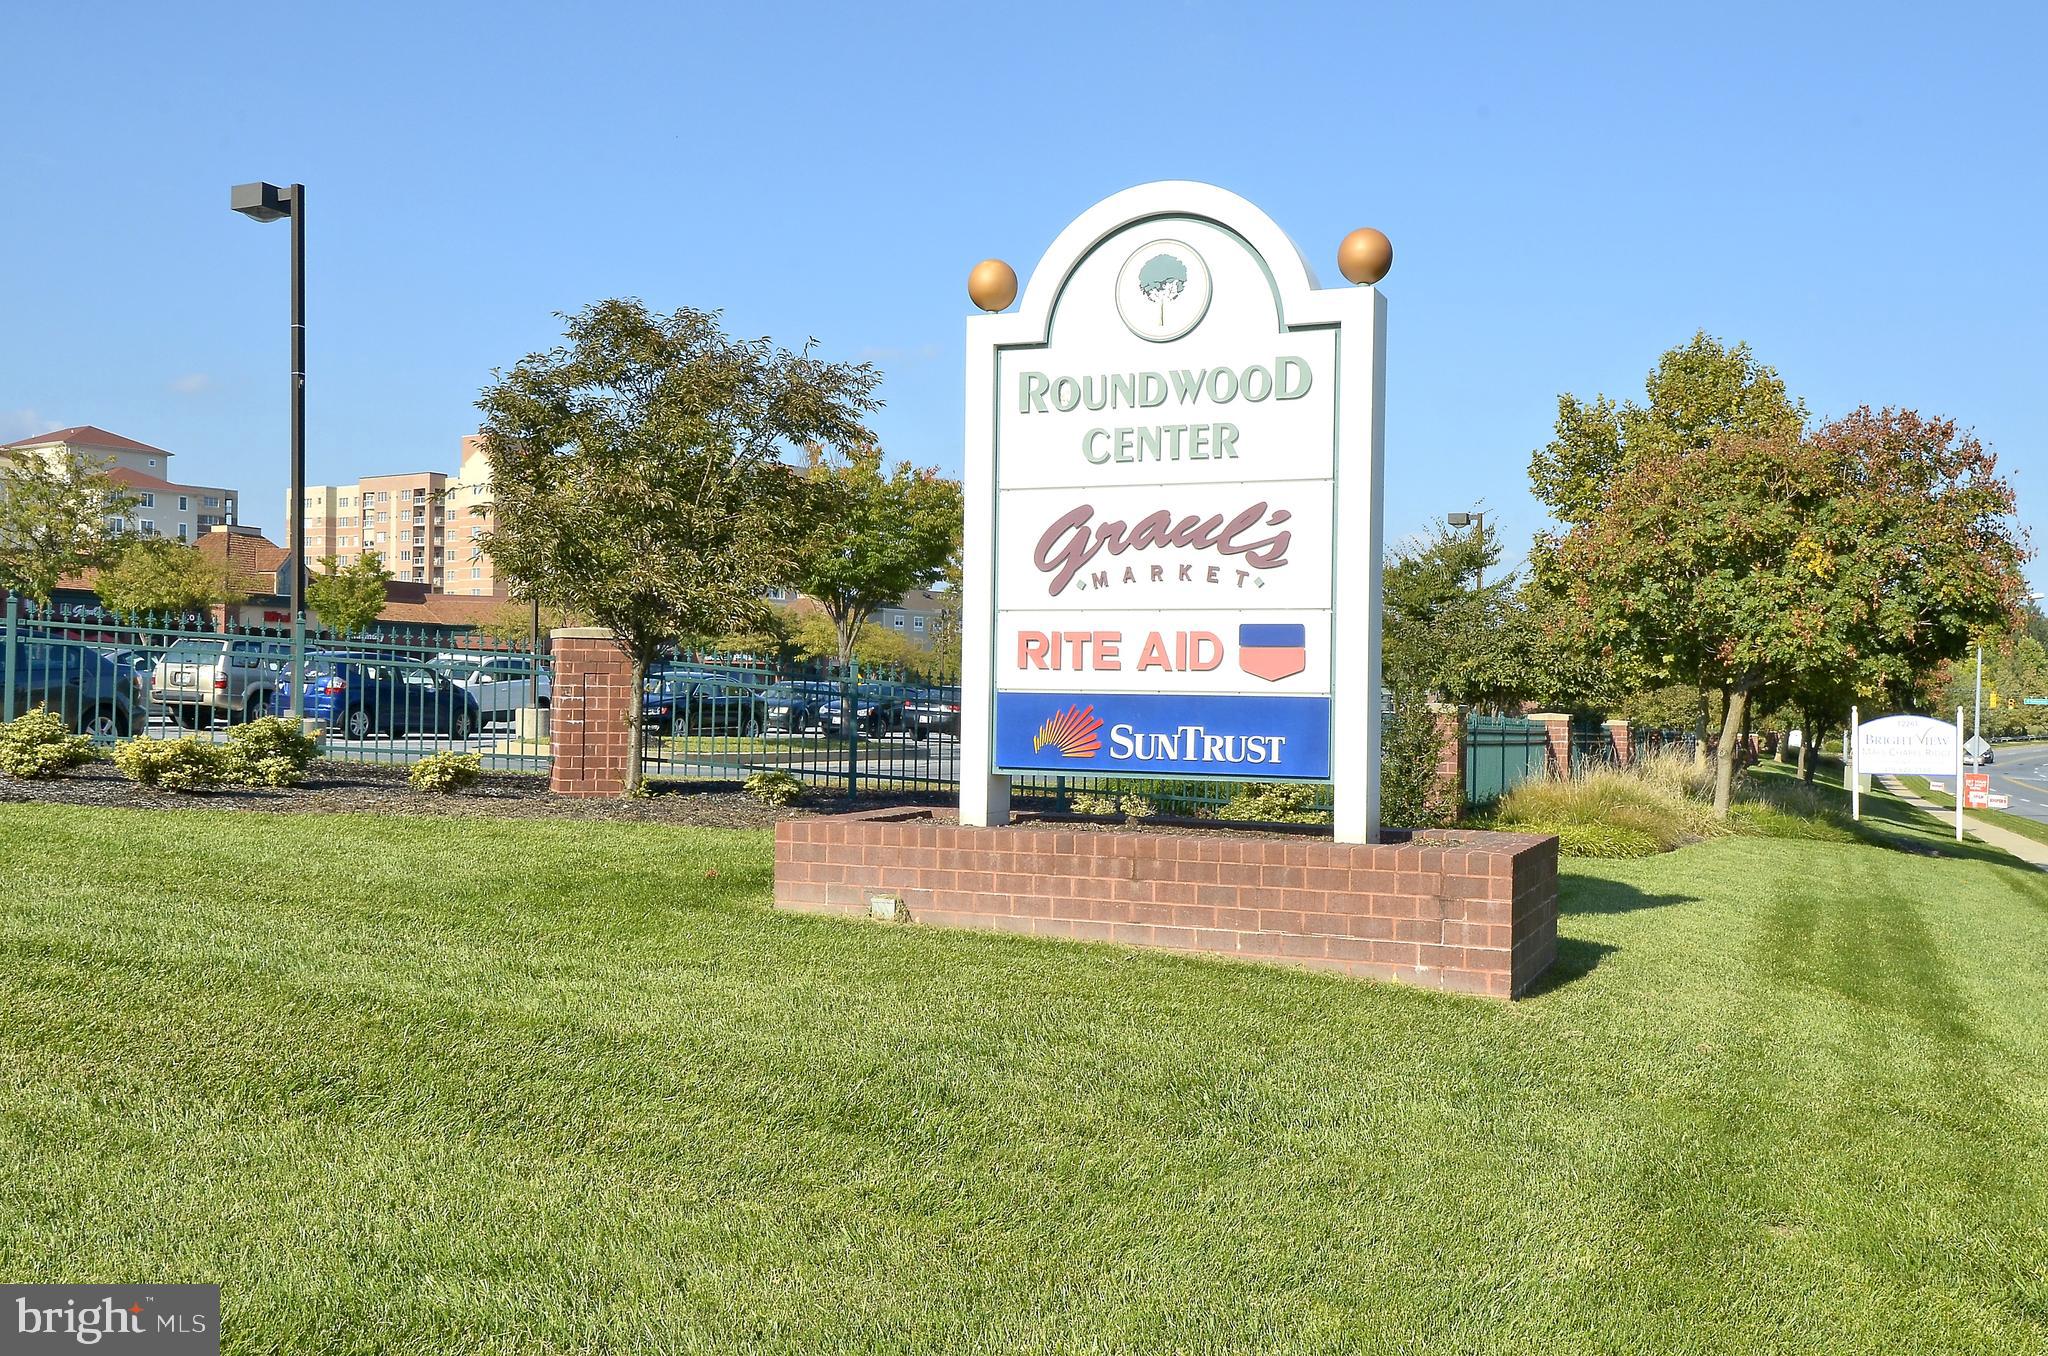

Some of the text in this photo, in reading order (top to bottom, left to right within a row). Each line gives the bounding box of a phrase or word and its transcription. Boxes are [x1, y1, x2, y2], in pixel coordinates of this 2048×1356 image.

[1019, 356, 1313, 414] ROUNDWOOD
[1082, 422, 1240, 464] CENTER
[1091, 564, 1250, 589] MARKET
[1017, 631, 1225, 672] RITE AID
